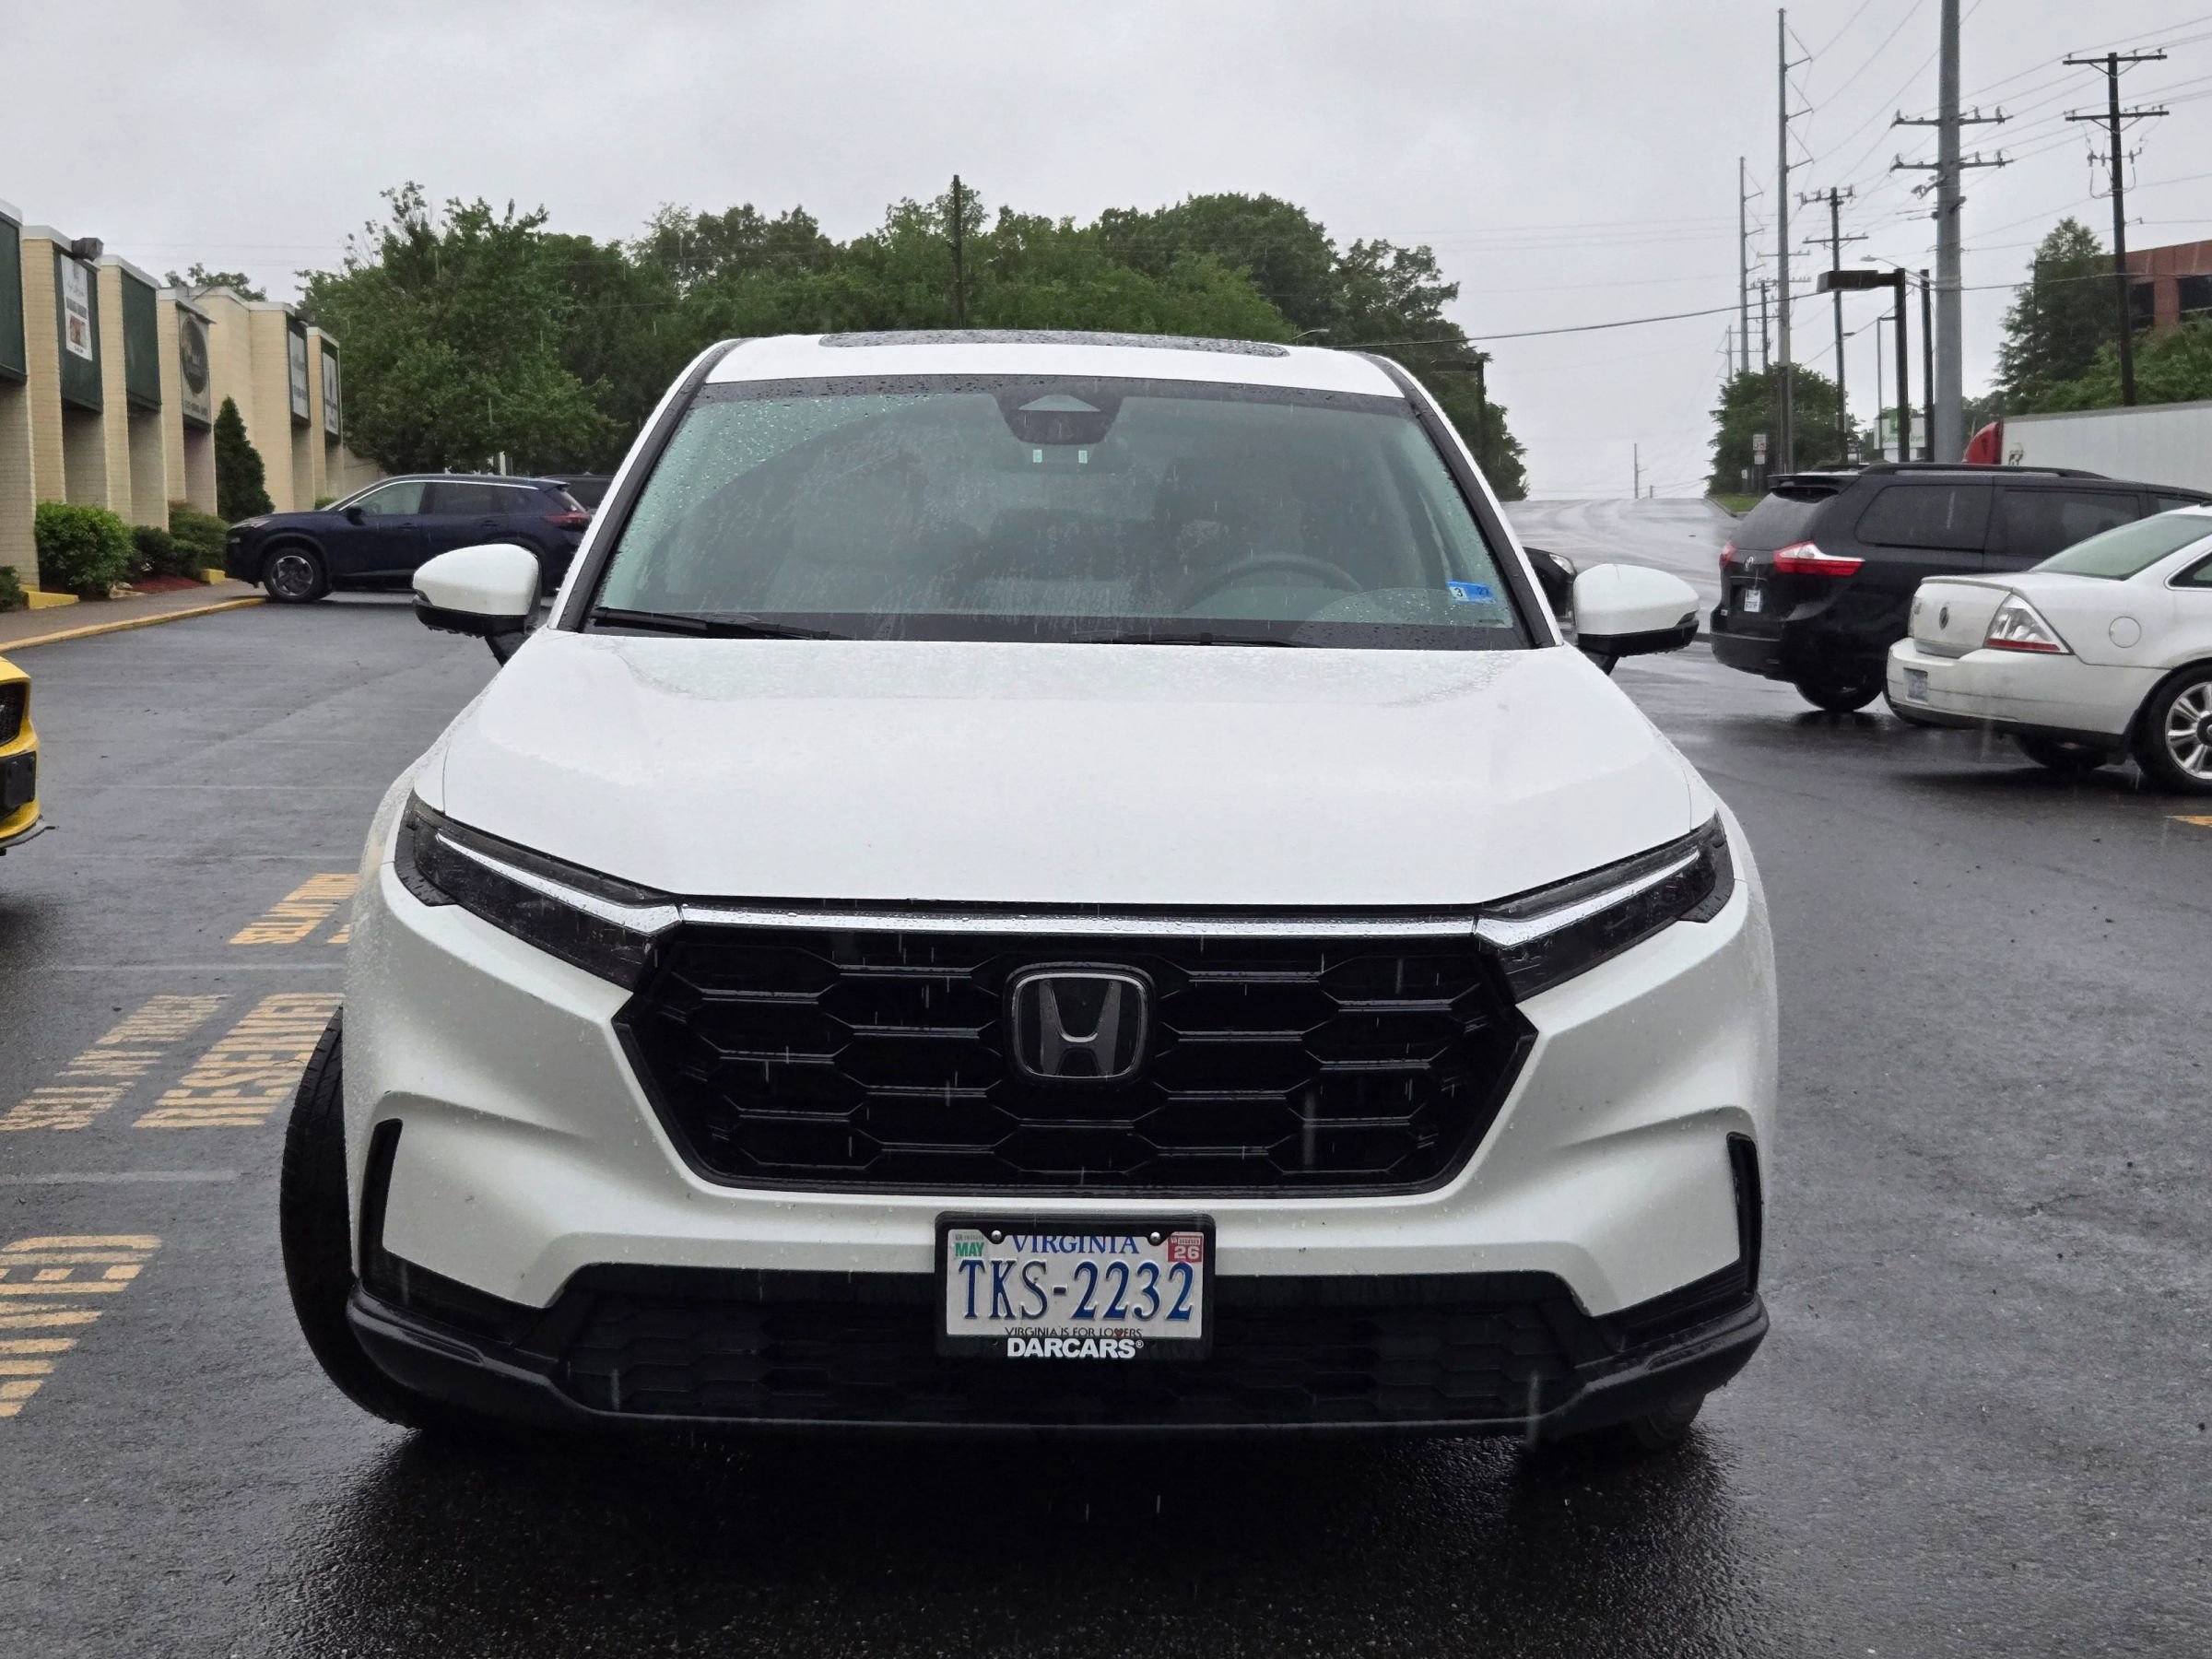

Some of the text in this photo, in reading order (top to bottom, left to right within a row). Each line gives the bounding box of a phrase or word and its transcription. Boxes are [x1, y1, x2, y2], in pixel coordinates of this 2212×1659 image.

[132, 993, 346, 1128] RESERVED
[955, 1241, 985, 1257] MAY
[1012, 1234, 1141, 1254] VIRGINIA
[1173, 1245, 1200, 1260] 26
[958, 1259, 1194, 1321] TKS-2232
[1005, 1326, 1057, 1336] VIRGINIA
[1061, 1327, 1069, 1336] IS
[1072, 1327, 1095, 1336] FOR
